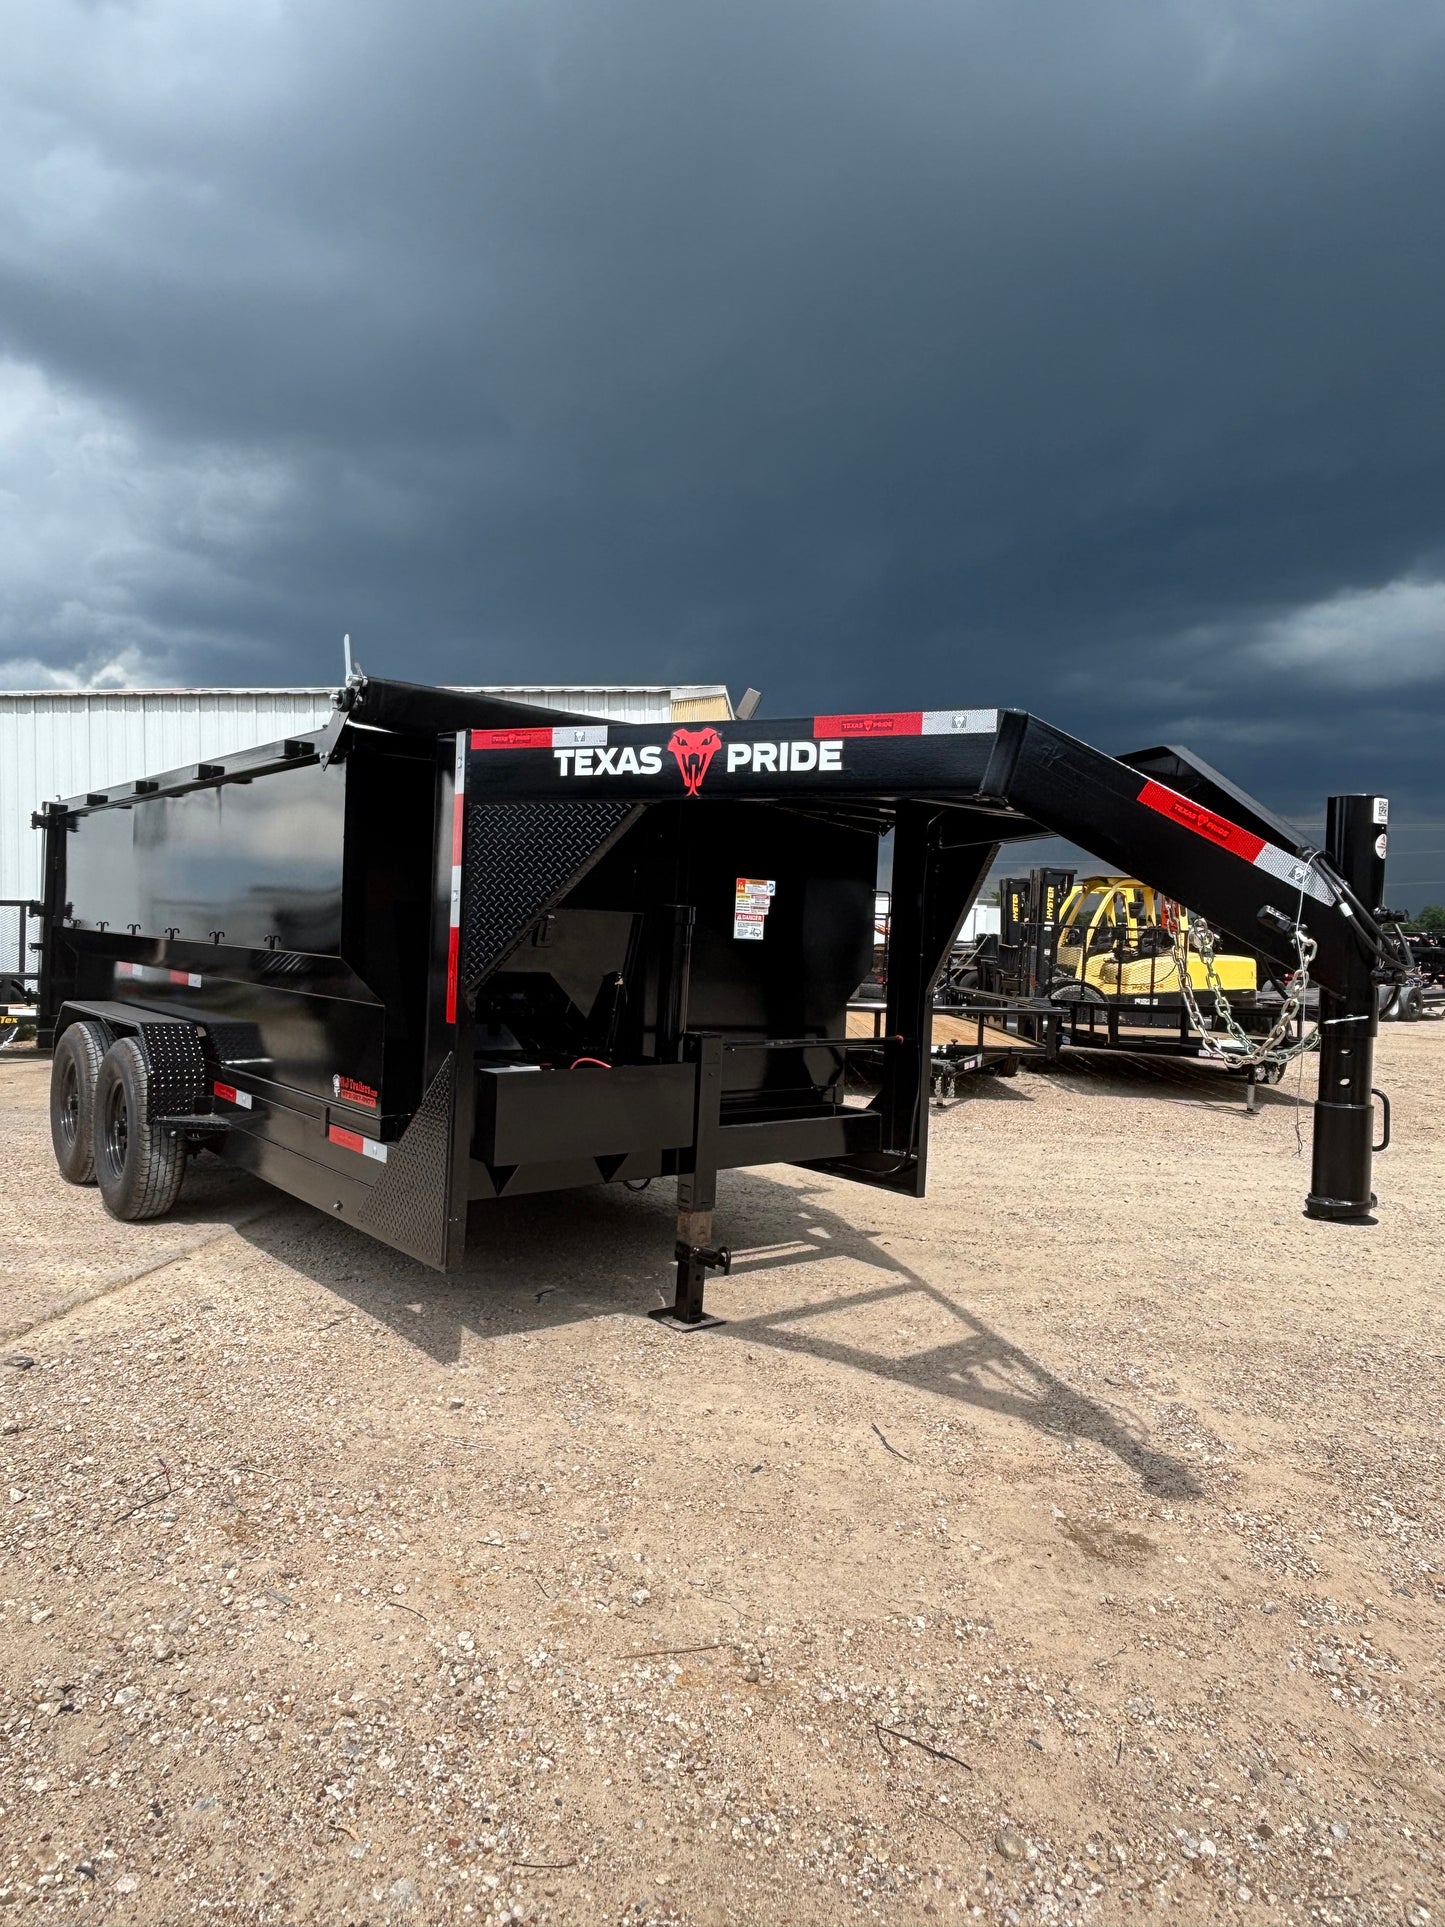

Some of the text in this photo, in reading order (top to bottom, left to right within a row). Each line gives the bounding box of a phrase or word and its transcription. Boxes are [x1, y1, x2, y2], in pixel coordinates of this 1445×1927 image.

[554, 741, 843, 777] TEXAS PRIDE
[1046, 886, 1055, 920] HYSTER
